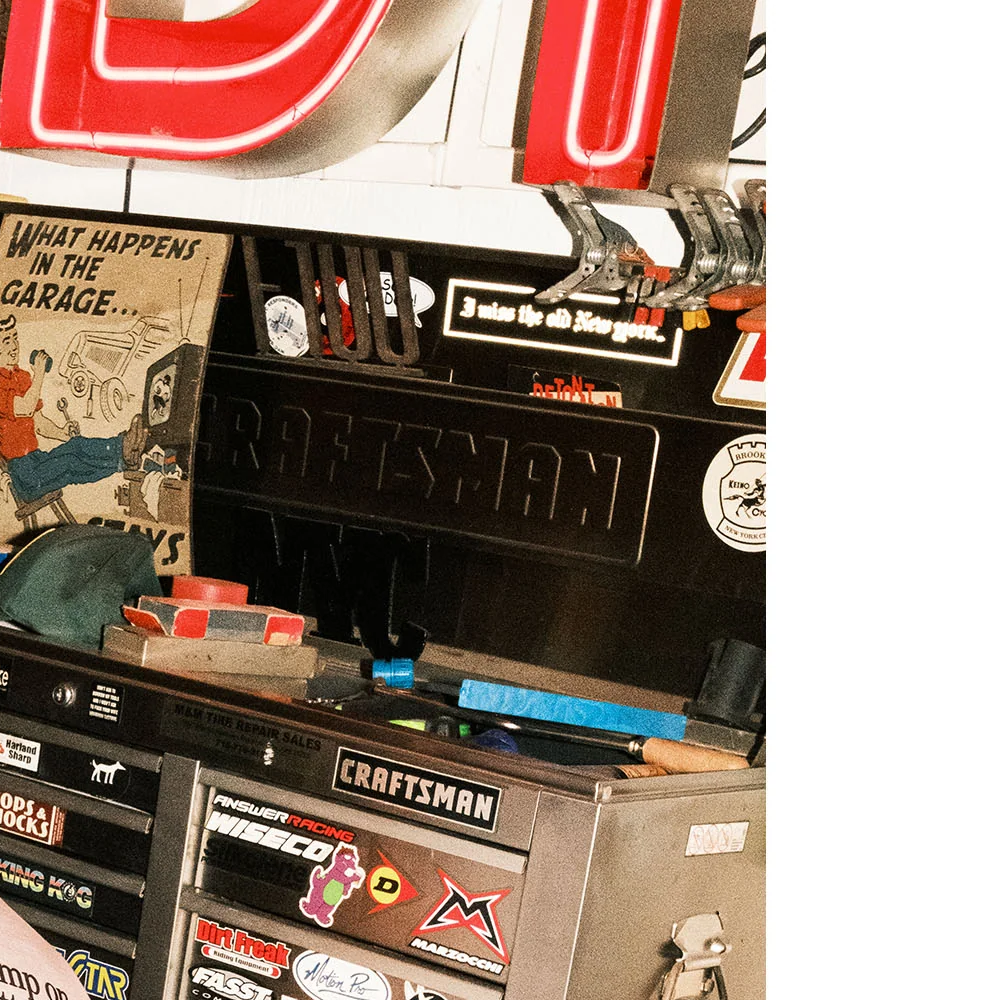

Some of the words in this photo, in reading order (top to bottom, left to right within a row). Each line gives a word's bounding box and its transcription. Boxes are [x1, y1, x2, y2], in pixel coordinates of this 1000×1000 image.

[6, 220, 86, 258] WHAT
[87, 229, 202, 261] HAPPENS
[29, 251, 55, 276] IN
[60, 254, 104, 281] THE
[0, 279, 138, 317] GARAGE...
[477, 302, 516, 323] miss
[518, 304, 545, 327] the
[545, 307, 572, 330] old
[573, 309, 612, 335] New
[5, 738, 37, 756] Harland
[236, 720, 280, 740] REPAIR
[282, 731, 322, 751] SALES
[8, 749, 32, 764] Sharp
[339, 757, 494, 822] CRAFTSMAN
[36, 807, 47, 820] &
[205, 810, 335, 863] WISECO
[195, 918, 235, 950] Dirt
[233, 928, 292, 969] Freak
[213, 948, 233, 964] Riding
[233, 956, 270, 974] Equipment
[410, 937, 505, 976] MARZOCCHI
[303, 957, 344, 993] Motion
[349, 972, 379, 996] Pro
